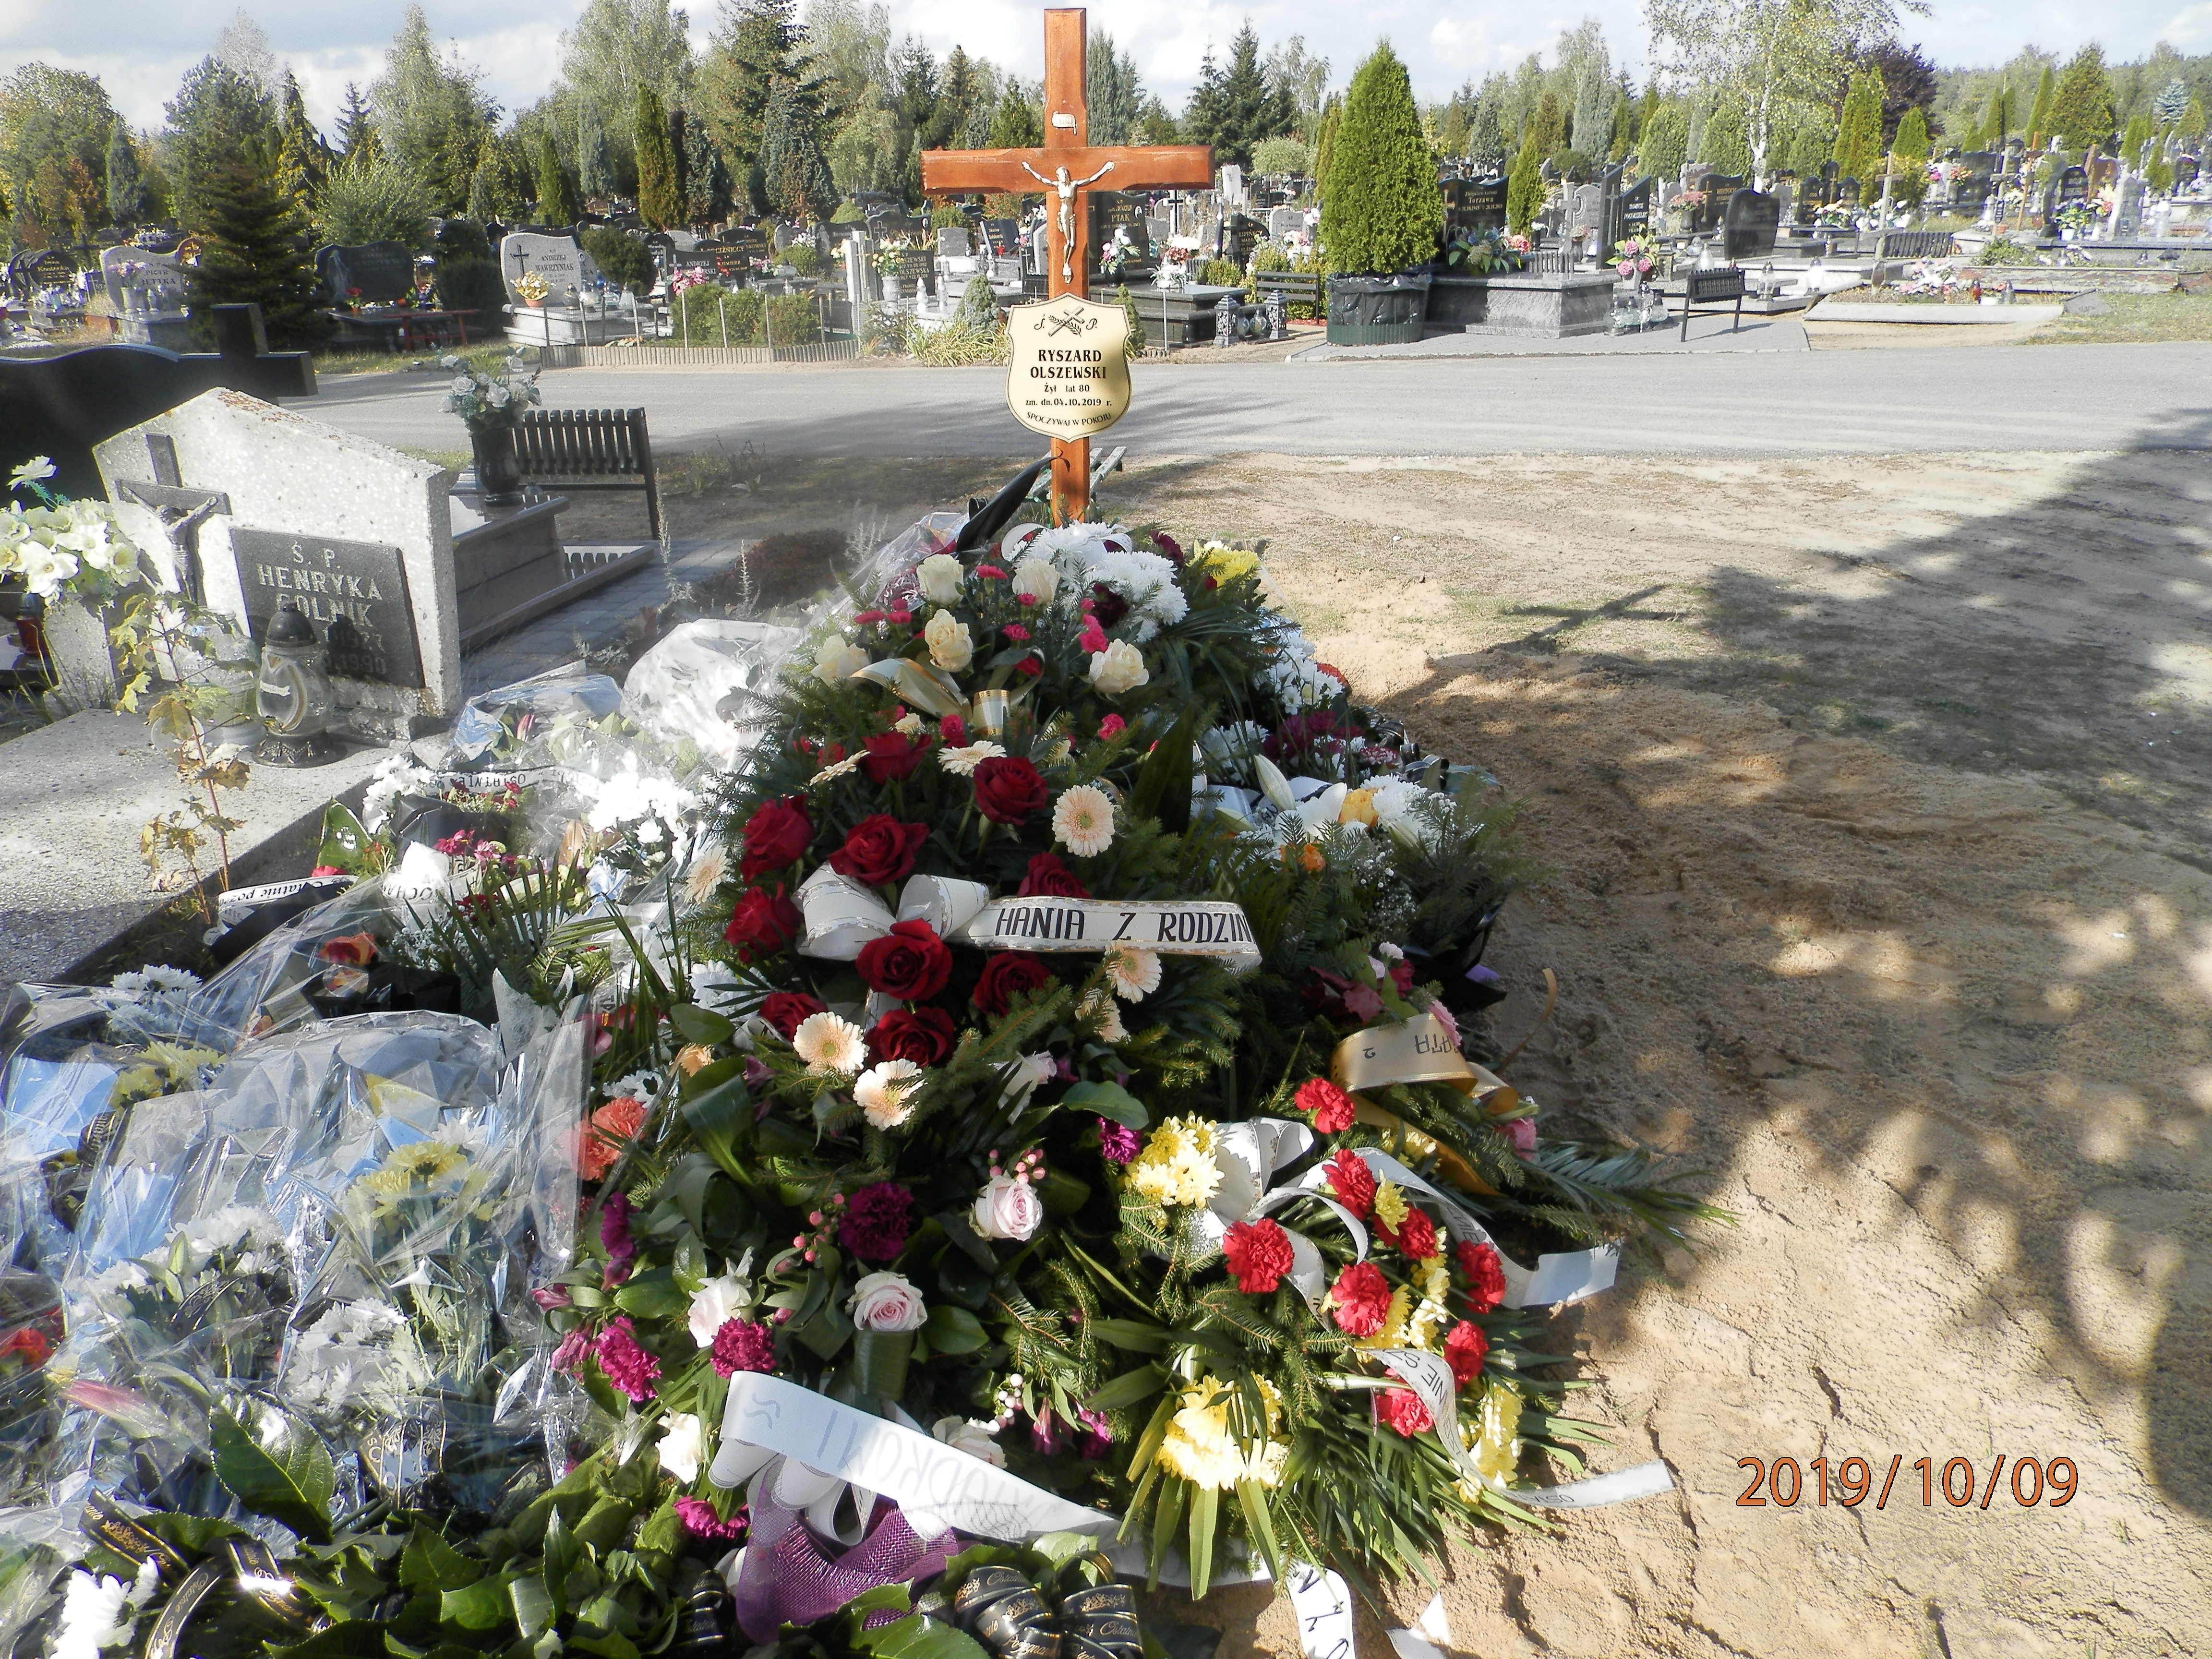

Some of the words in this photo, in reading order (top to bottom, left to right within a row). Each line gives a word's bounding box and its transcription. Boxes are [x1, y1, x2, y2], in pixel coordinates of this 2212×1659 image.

[1111, 214, 1130, 222] PTAK
[535, 263, 574, 272] WAWRZYNIAK
[1086, 318, 1098, 330] P.
[1038, 349, 1102, 362] RYSZARD
[1030, 366, 1106, 379] OLSZEWSKI
[1044, 382, 1057, 394] Żył
[1026, 411, 1070, 426] SPOCZYWAJ
[1082, 412, 1111, 426] POKOJU
[323, 548, 341, 569] P.
[256, 563, 383, 601] HENRYKA
[995, 906, 1085, 940] HANIA
[1113, 913, 1137, 941] Z
